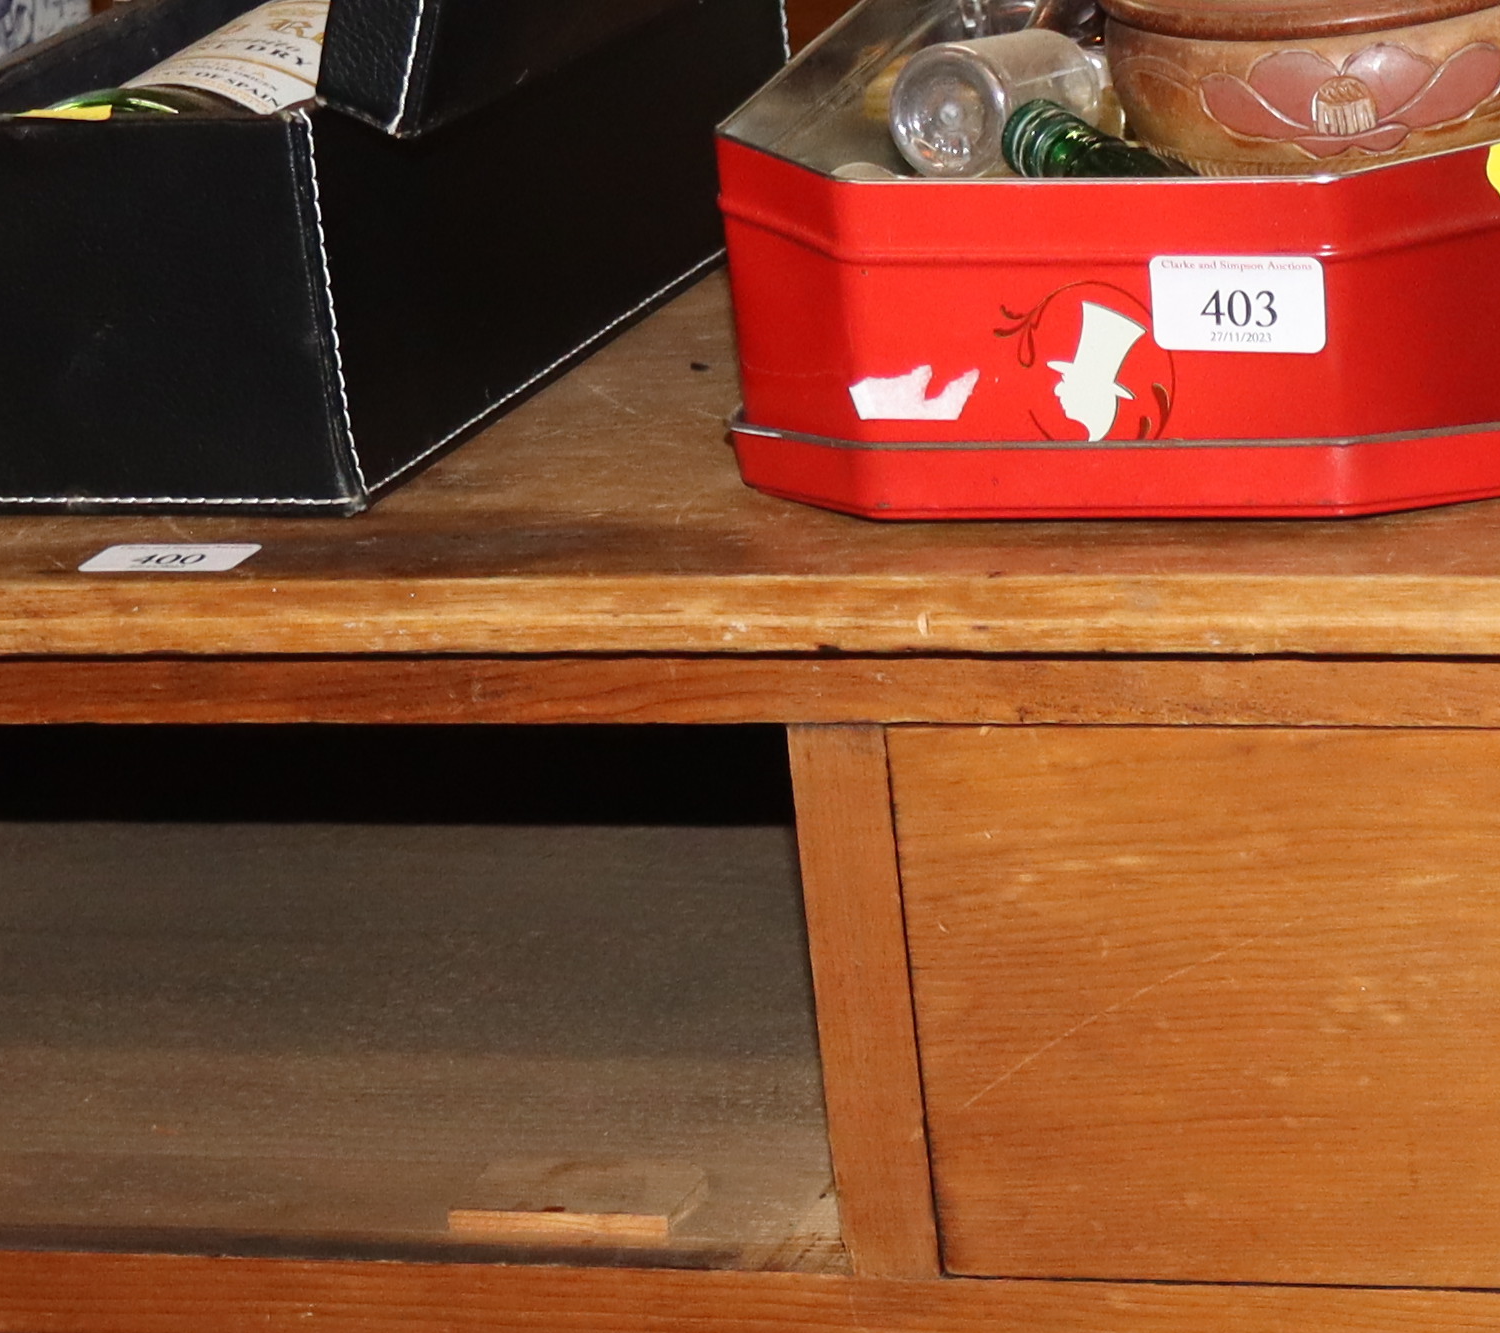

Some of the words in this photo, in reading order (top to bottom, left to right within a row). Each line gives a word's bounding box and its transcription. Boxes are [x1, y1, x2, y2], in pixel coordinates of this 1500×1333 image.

[245, 44, 311, 66] DRY
[227, 77, 284, 108] SPAIN
[1161, 259, 1195, 270] Clarke
[1199, 260, 1217, 270] and
[1220, 260, 1264, 272] Simpson
[1267, 260, 1313, 271] Auctions
[1200, 289, 1278, 328] 403
[1210, 332, 1272, 343] 27/11/2023
[131, 553, 206, 565] 400
